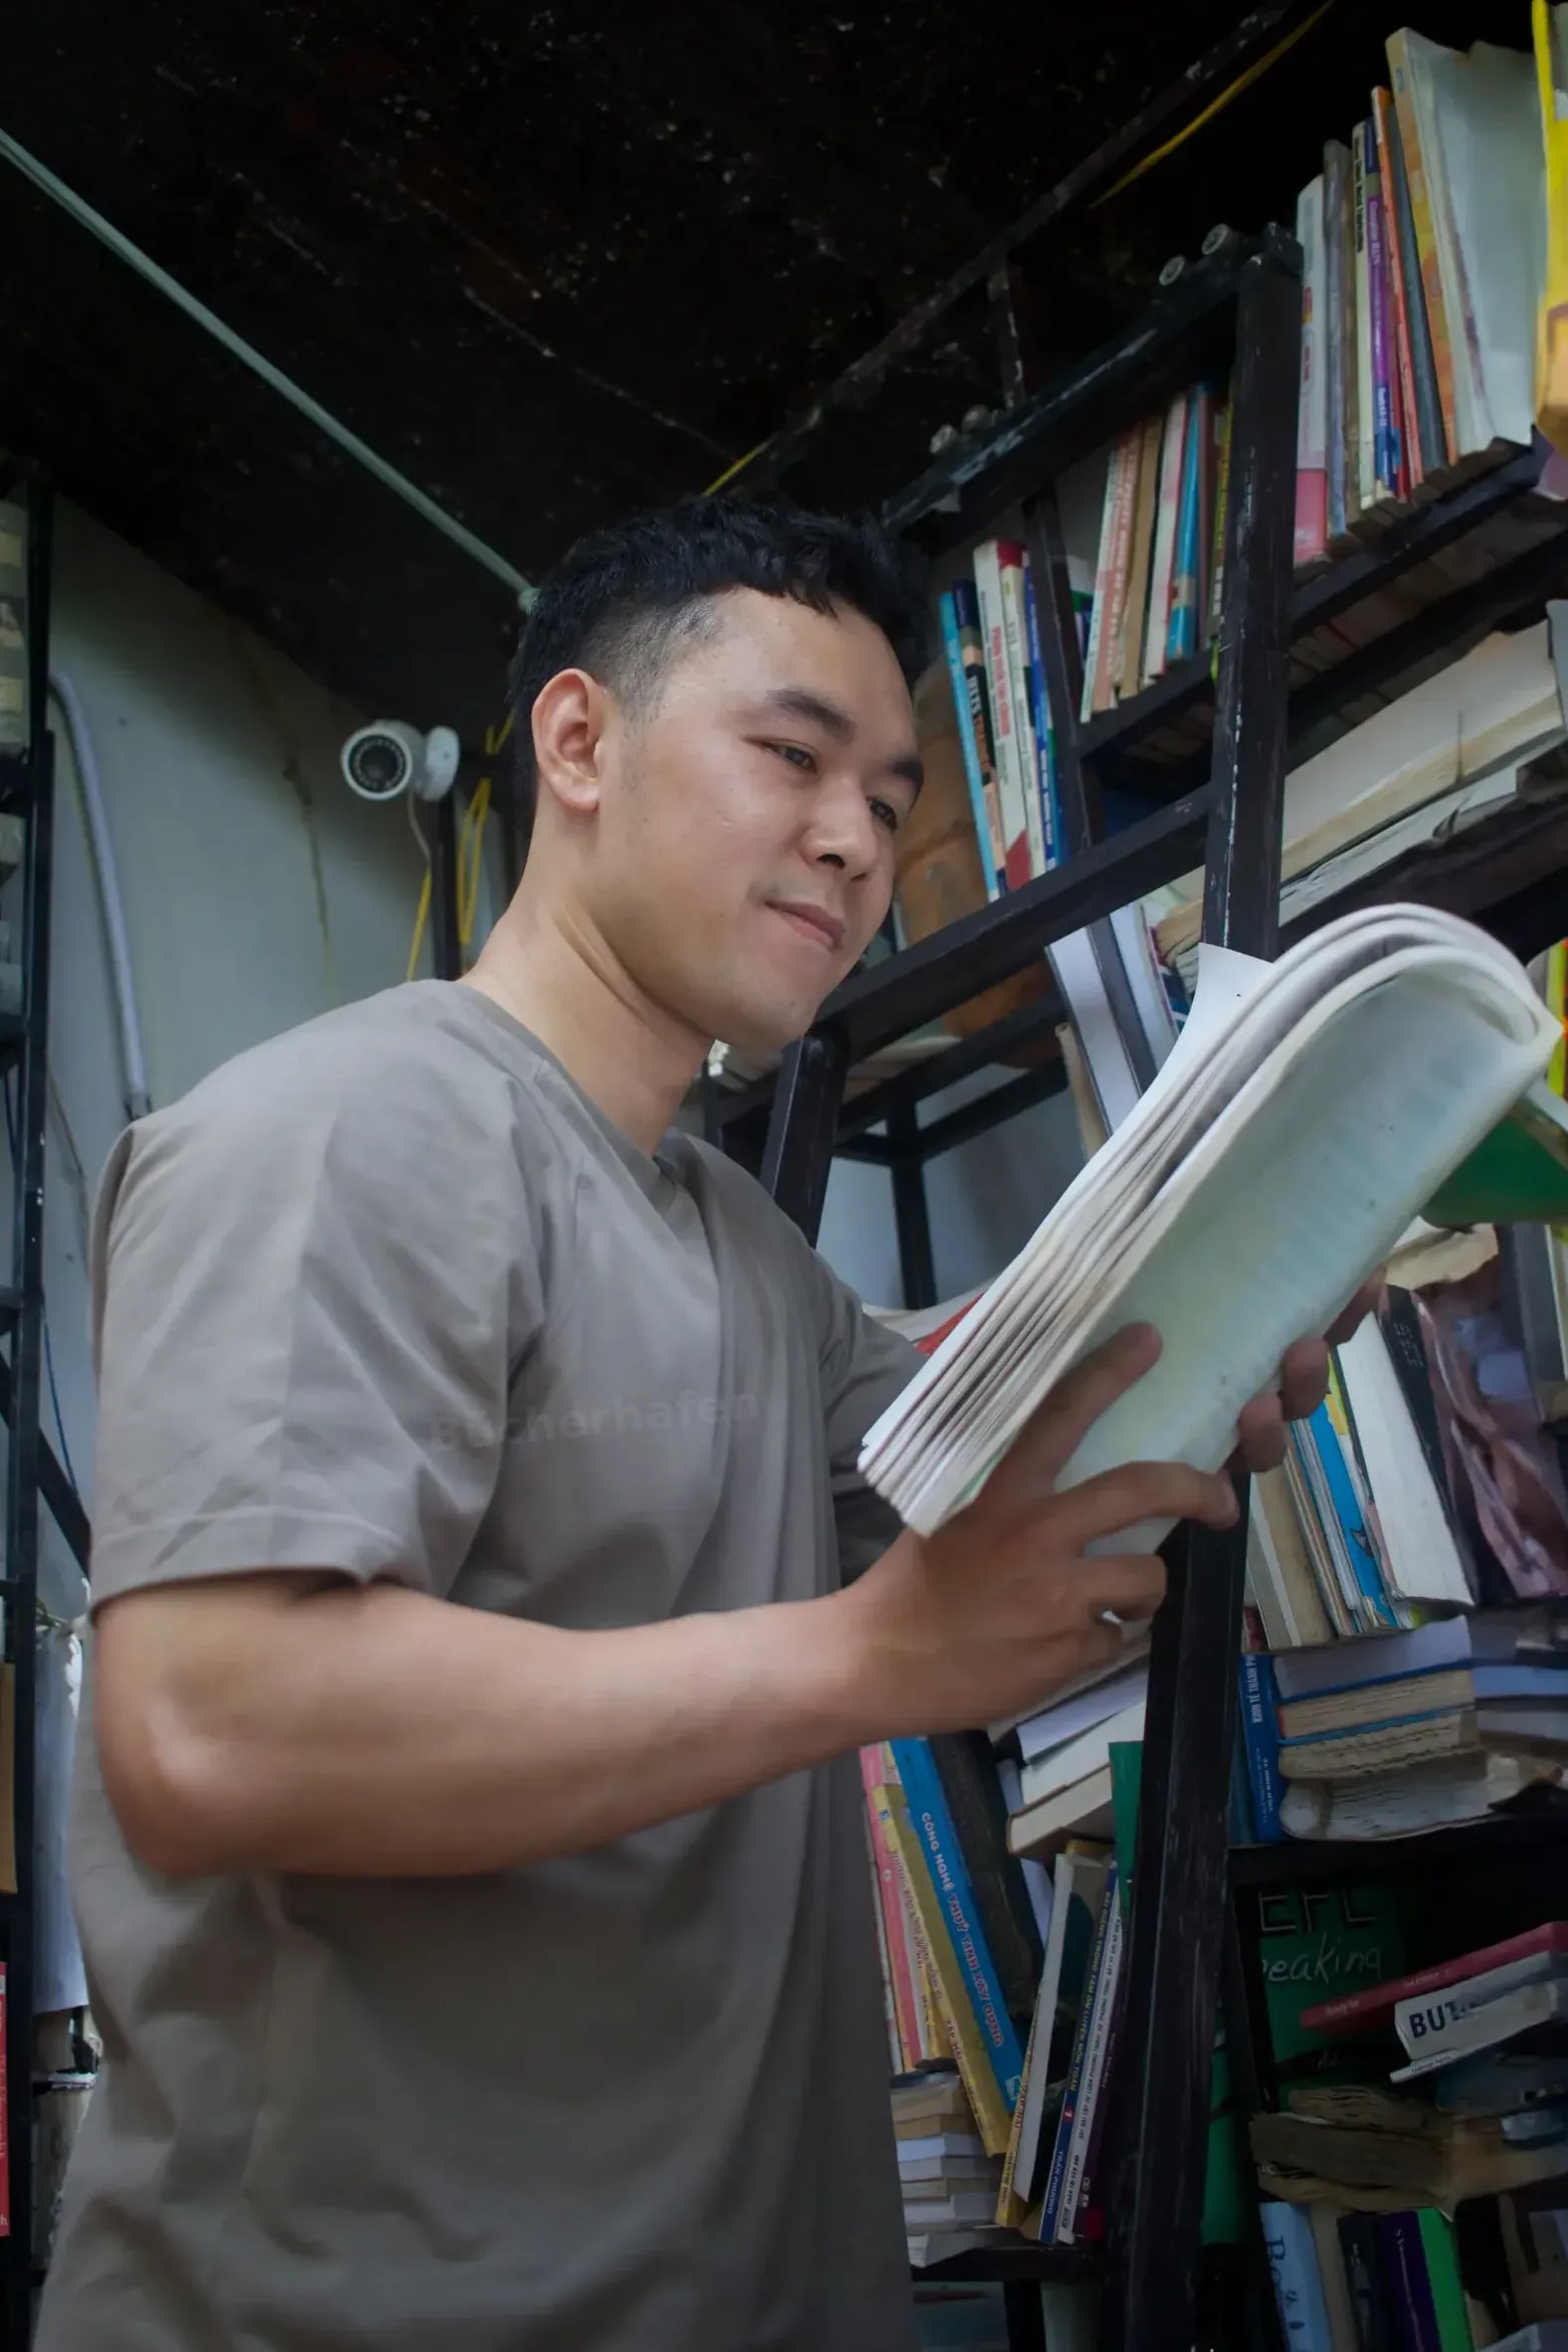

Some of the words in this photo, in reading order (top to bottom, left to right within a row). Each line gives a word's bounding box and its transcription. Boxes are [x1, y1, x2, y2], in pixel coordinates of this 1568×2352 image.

[1250, 1702, 1263, 1723] KINH
[921, 1812, 940, 1852] CÔNG
[934, 1853, 955, 1892] NGHỆ
[961, 1935, 978, 1970] TINH
[1262, 1932, 1381, 1983] eaking
